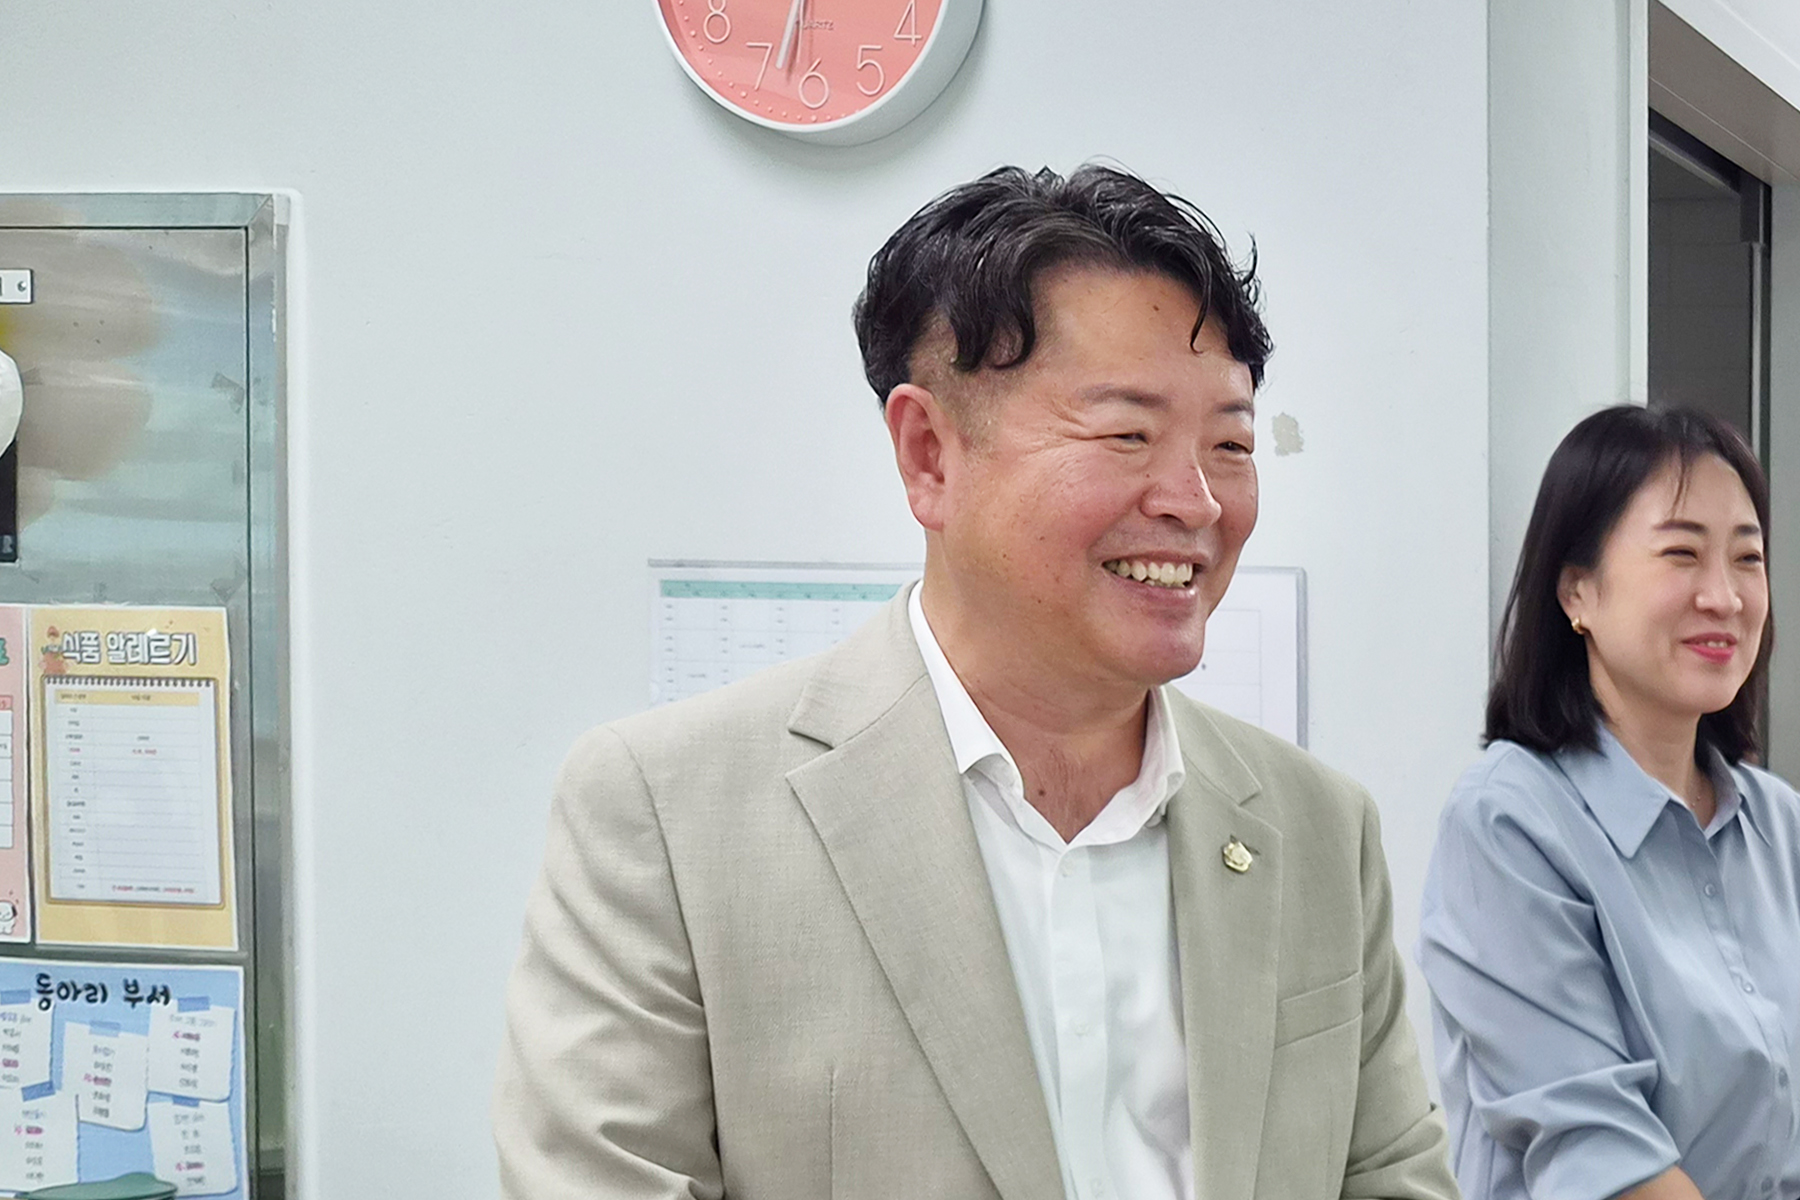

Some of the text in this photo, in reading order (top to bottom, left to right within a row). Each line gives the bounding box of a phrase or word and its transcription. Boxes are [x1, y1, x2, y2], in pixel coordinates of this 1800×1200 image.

[703, 0, 732, 43] 8
[893, 0, 922, 46] 4
[746, 42, 774, 90] 7
[800, 58, 829, 108] 6
[856, 45, 885, 96] 5
[61, 632, 197, 665] 식품 알레르기
[35, 973, 171, 1011] 동아리 부서
